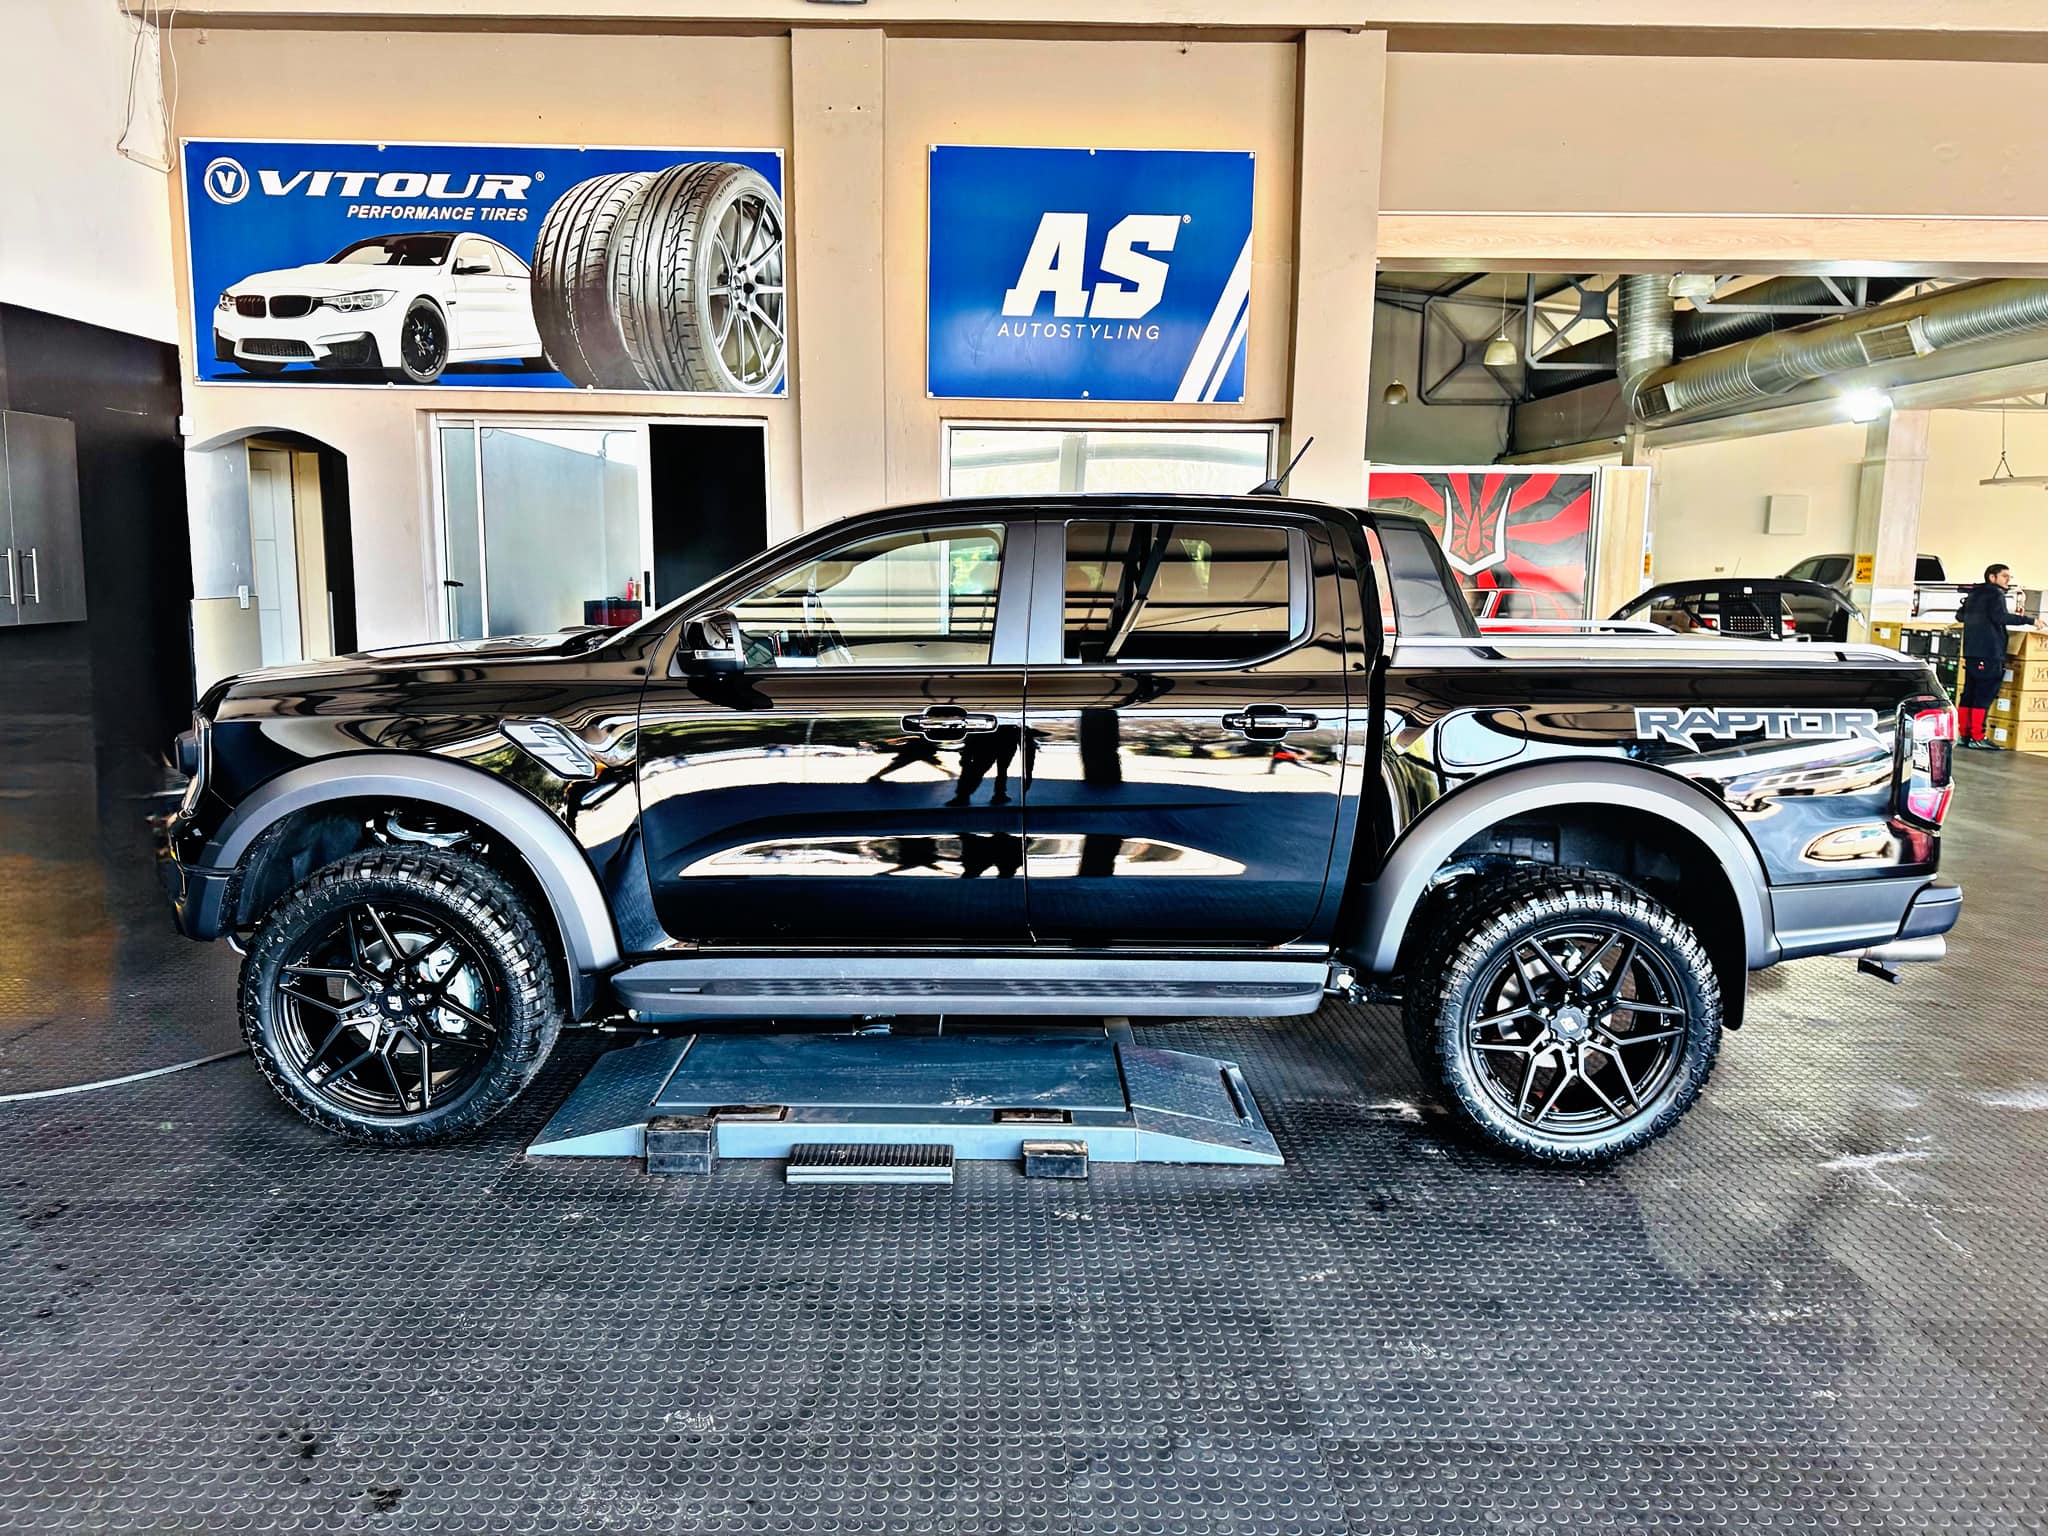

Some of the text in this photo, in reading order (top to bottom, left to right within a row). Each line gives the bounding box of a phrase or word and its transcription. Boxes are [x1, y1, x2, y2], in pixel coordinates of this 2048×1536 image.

[257, 170, 532, 200] VITOUR
[347, 205, 528, 221] PERFORMANCE TIRES
[1001, 212, 1182, 319] AS
[997, 322, 1161, 340] AUTOSTYLING
[1634, 707, 1891, 754] RAPTOR
